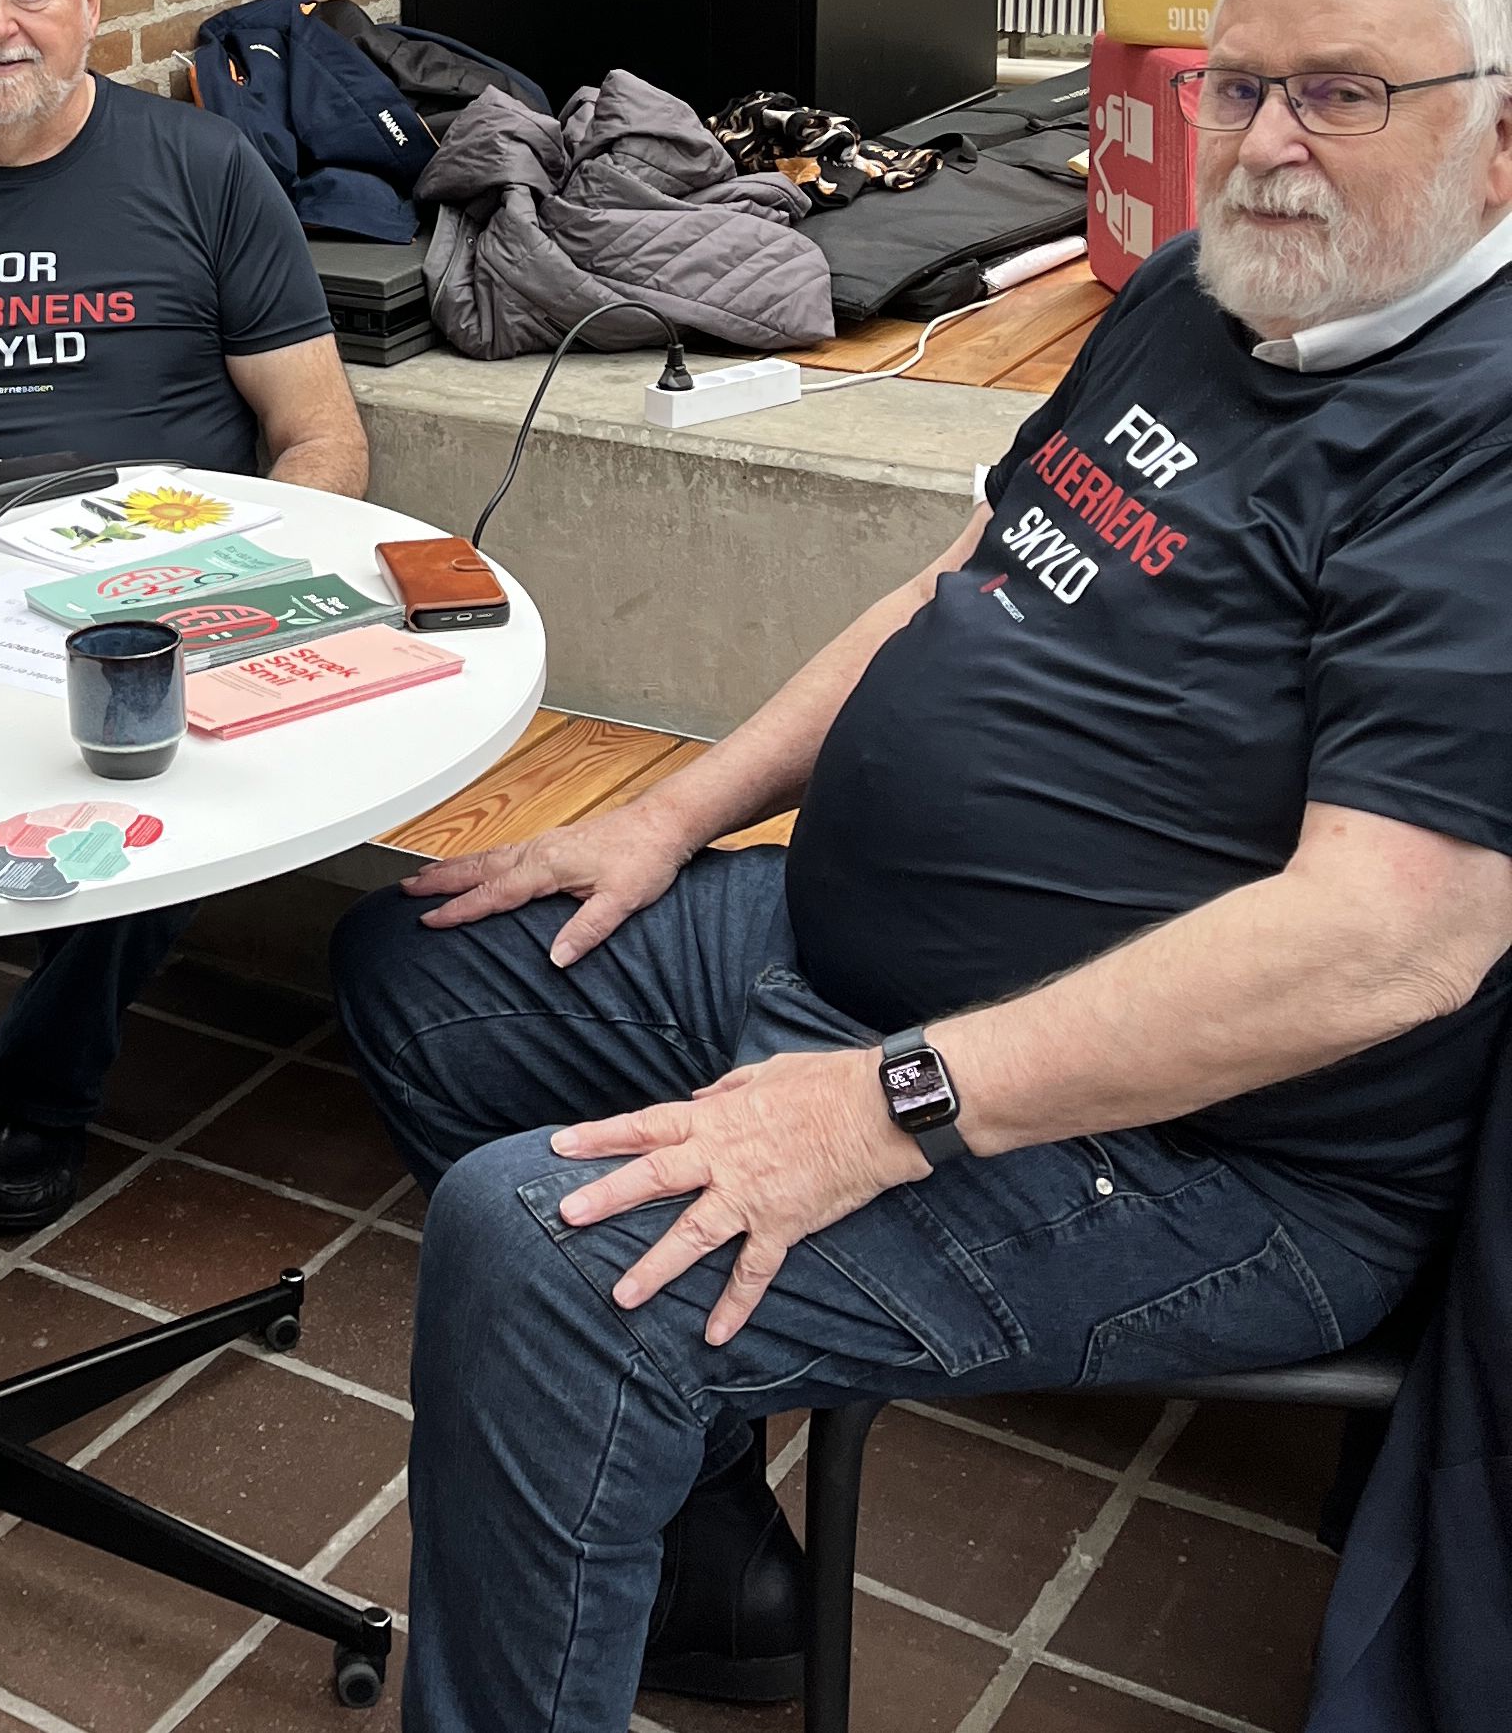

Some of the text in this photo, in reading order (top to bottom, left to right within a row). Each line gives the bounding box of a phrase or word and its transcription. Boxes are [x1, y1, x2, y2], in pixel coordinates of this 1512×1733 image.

[378, 109, 409, 147] NANOK
[1103, 403, 1199, 489] FOR
[1030, 429, 1188, 577] HJERNENS
[1001, 506, 1100, 605] SKYLD
[239, 661, 298, 687] Smil
[265, 655, 325, 682] Snak
[290, 648, 361, 679] Stræk
